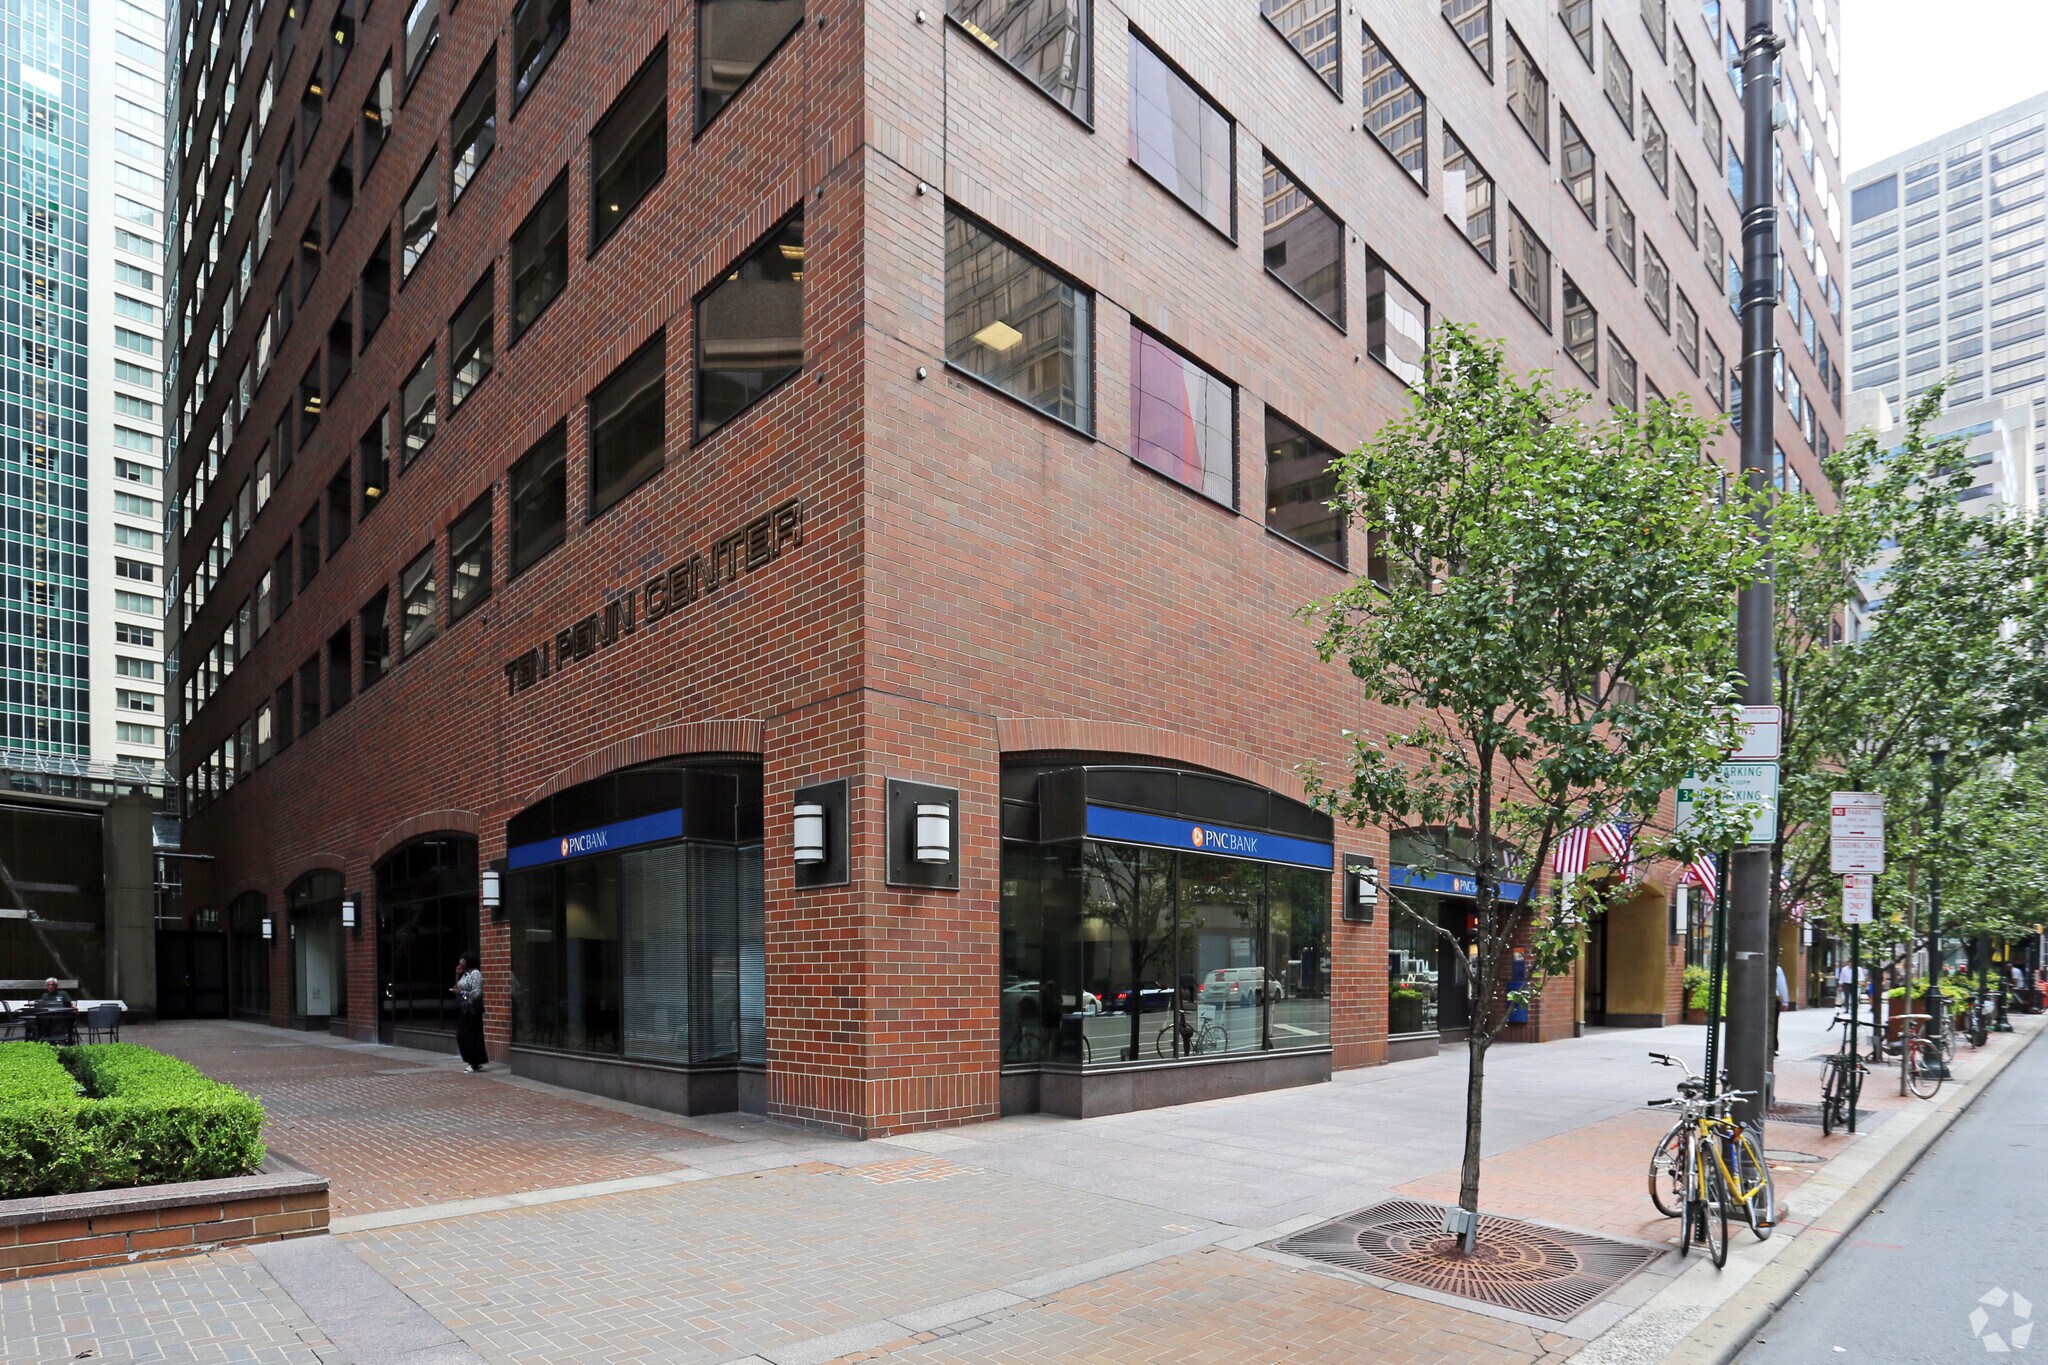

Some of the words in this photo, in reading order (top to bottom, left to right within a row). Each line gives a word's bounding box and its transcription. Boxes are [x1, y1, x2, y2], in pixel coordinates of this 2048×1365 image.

[505, 641, 550, 696] TEN
[556, 591, 636, 671] PENN
[645, 496, 803, 622] CENTER
[1682, 790, 1690, 801] 3
